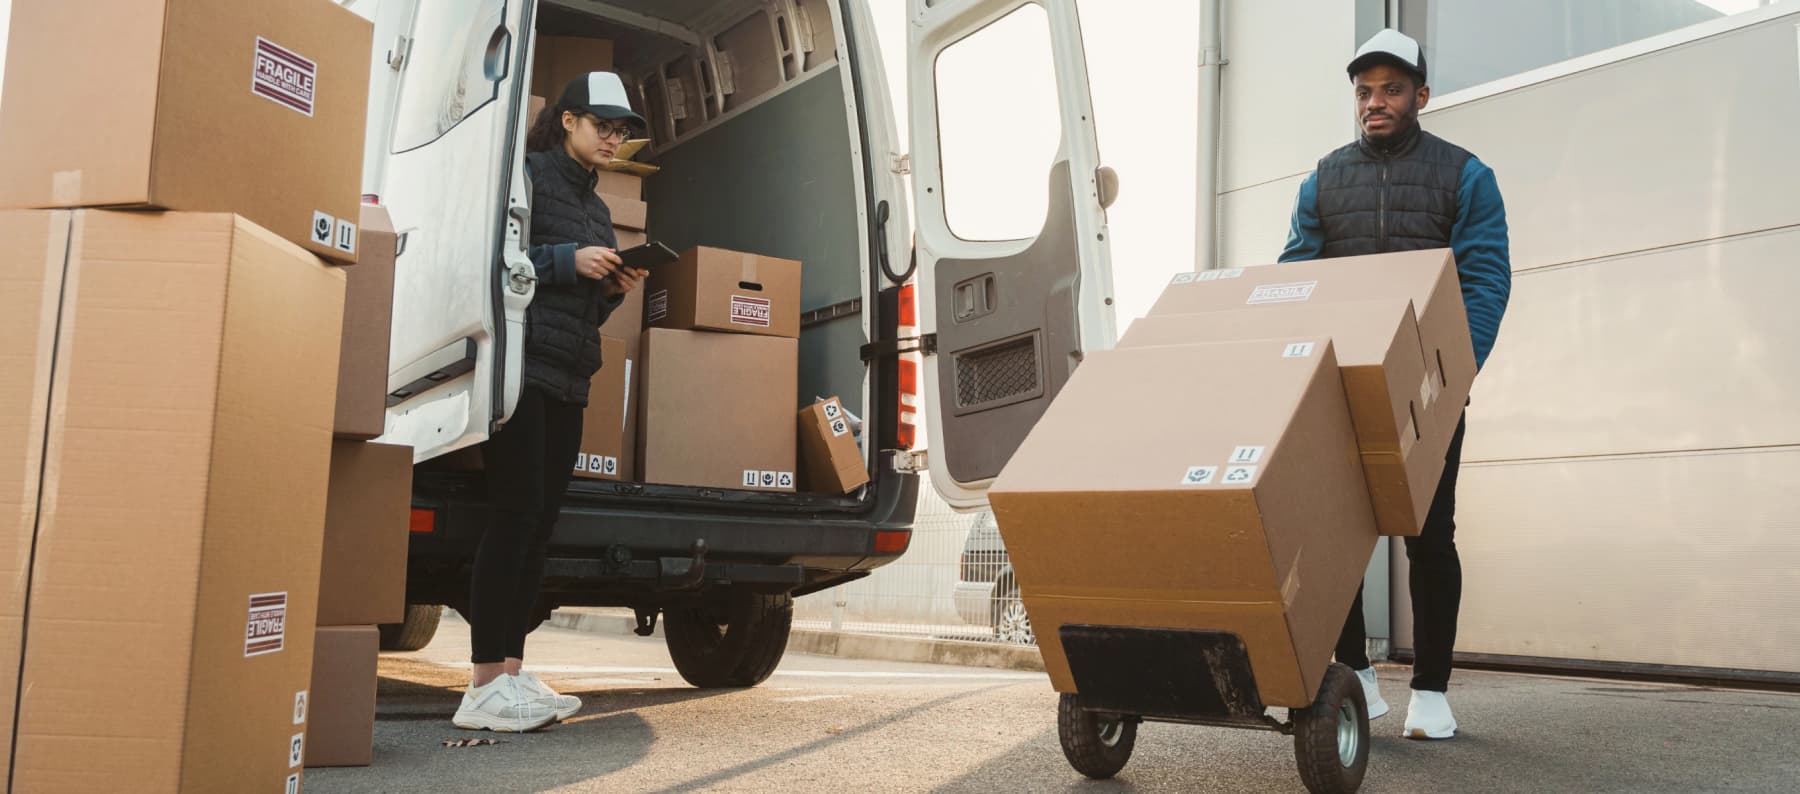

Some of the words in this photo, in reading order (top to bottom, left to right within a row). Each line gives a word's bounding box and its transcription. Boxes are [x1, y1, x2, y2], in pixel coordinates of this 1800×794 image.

[257, 55, 312, 93] FRAGILE
[733, 306, 768, 318] FRAGILE
[247, 617, 284, 637] FRAGILE
